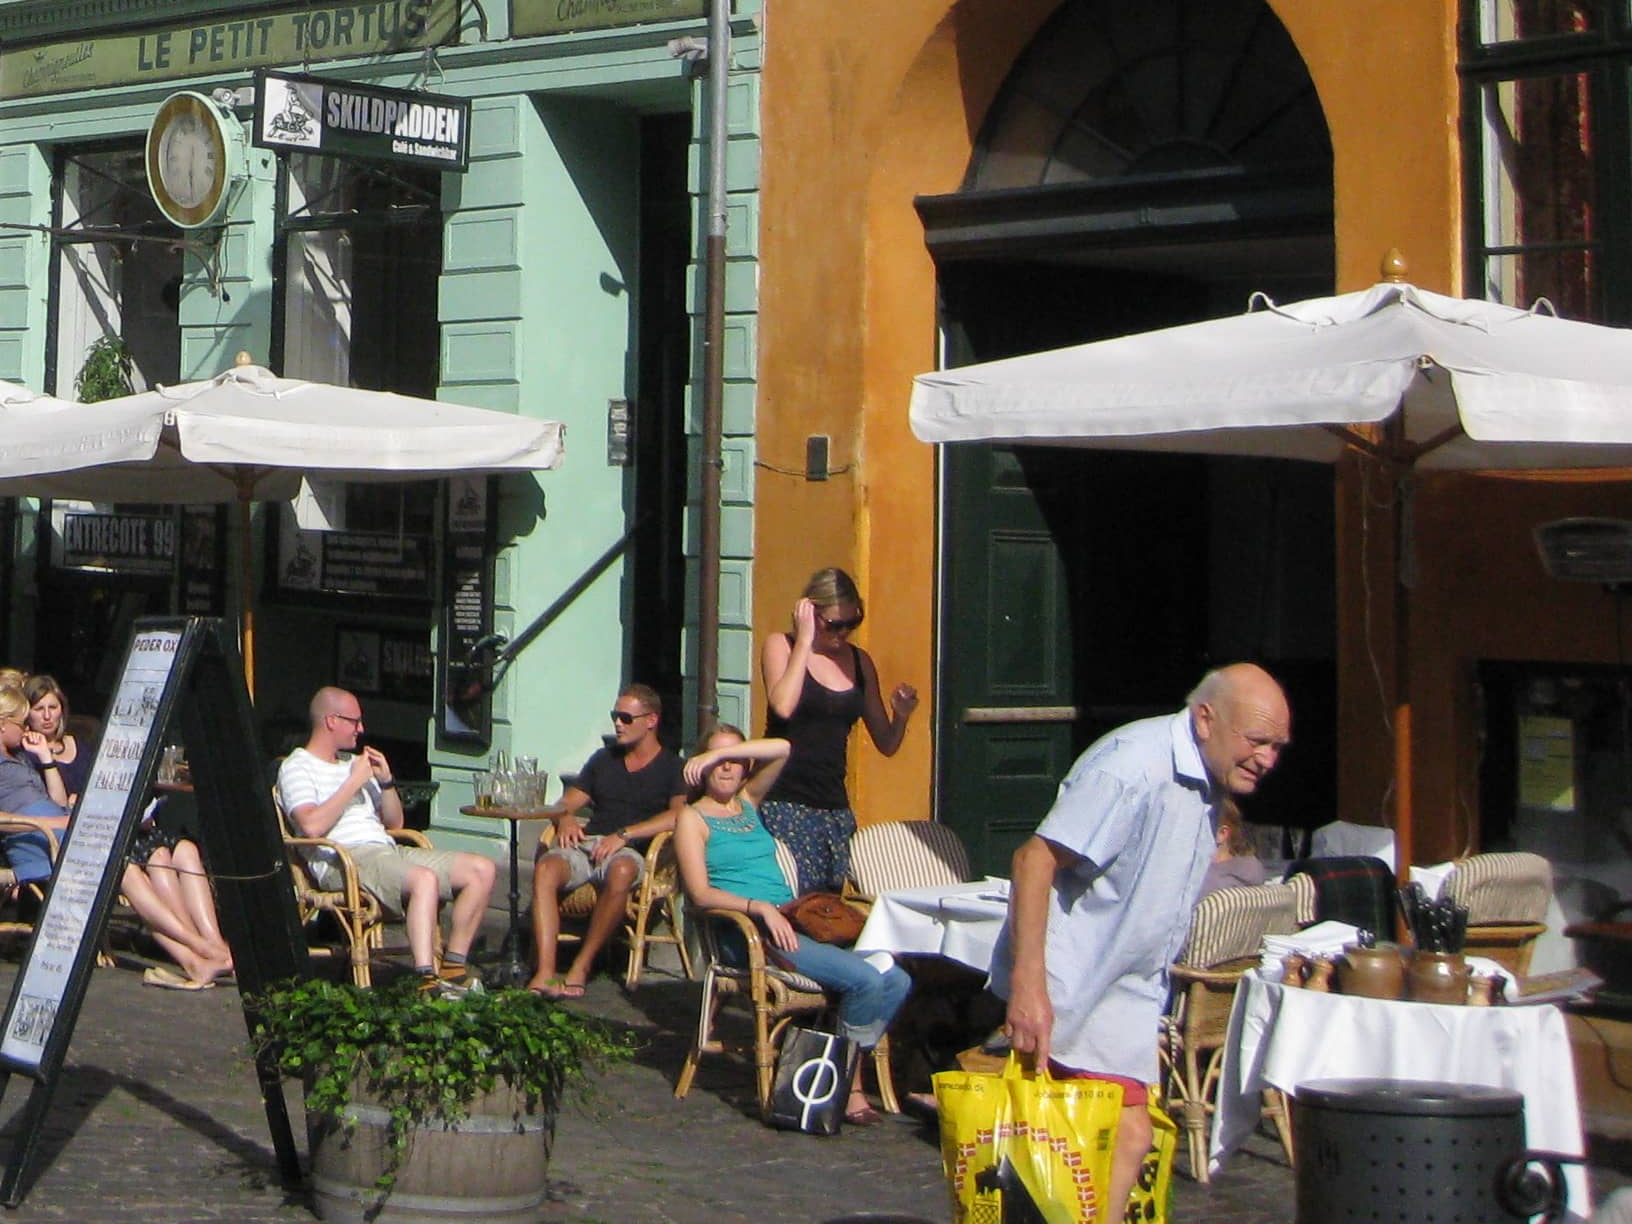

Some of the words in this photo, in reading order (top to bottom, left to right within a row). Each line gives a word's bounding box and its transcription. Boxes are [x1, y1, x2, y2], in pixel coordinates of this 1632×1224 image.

[137, 33, 172, 72] LE
[189, 19, 274, 65] PETIT
[327, 91, 460, 145] SKILDPADDEN
